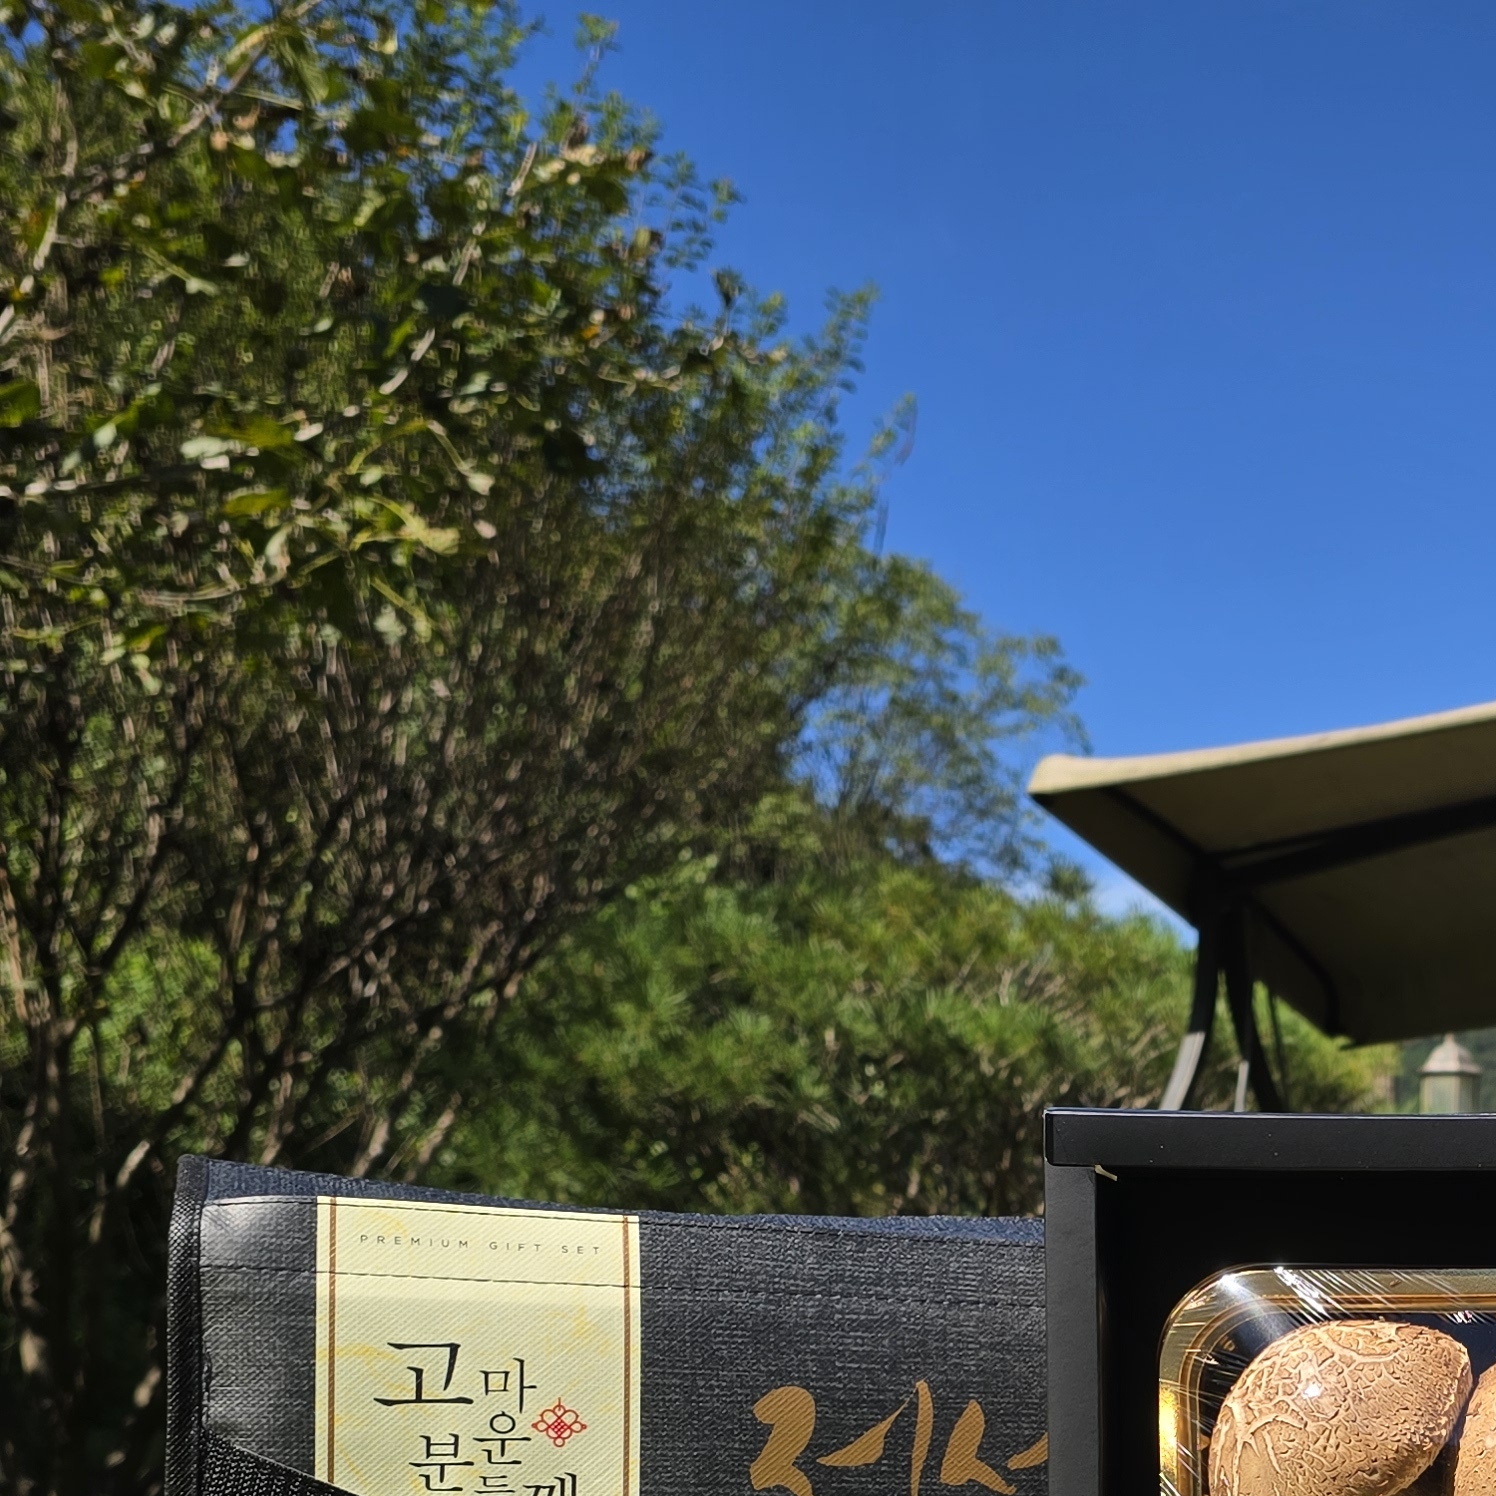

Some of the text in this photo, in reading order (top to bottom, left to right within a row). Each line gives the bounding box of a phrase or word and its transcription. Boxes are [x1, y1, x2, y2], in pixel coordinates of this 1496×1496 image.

[359, 1234, 600, 1255] PREMIUM GIFT SET
